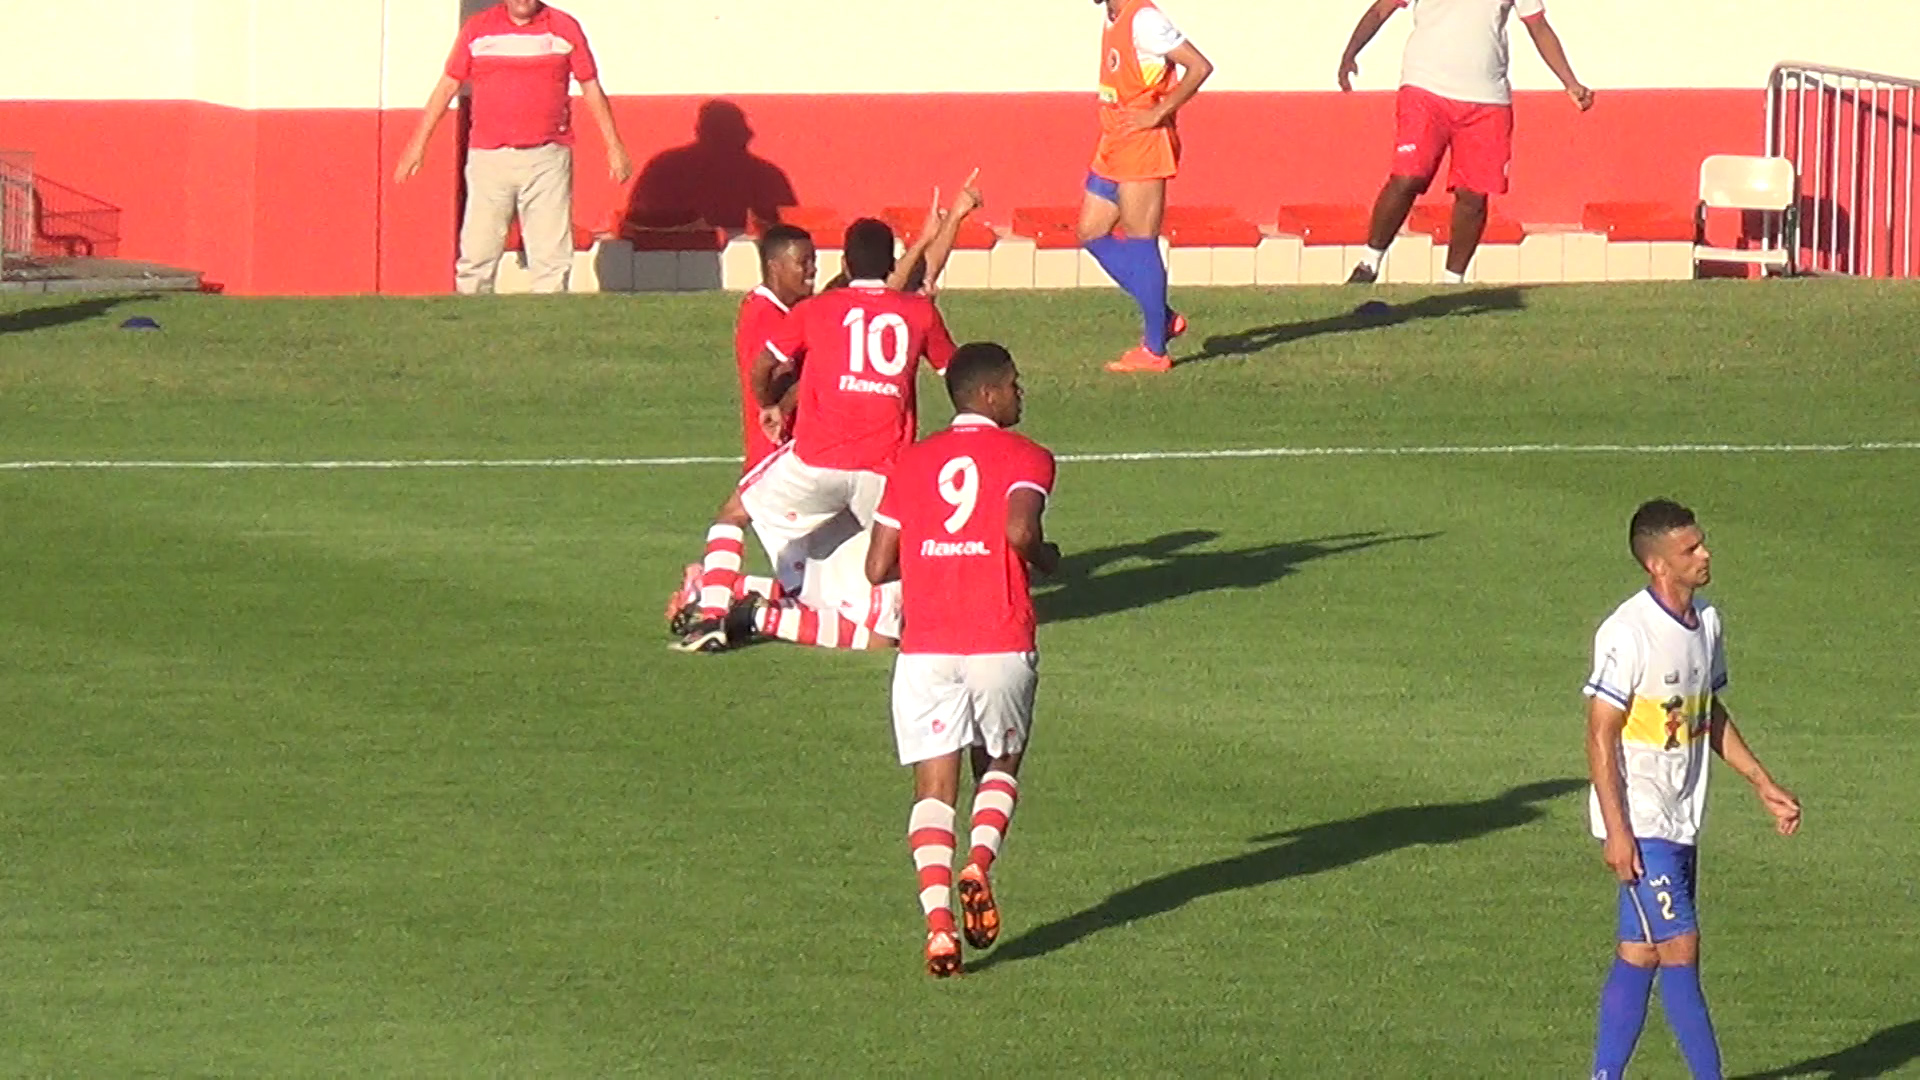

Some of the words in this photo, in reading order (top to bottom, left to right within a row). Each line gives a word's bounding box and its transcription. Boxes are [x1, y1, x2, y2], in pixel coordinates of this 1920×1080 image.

[842, 307, 908, 376] 10
[938, 455, 979, 534] 9
[1657, 891, 1676, 920] 2
